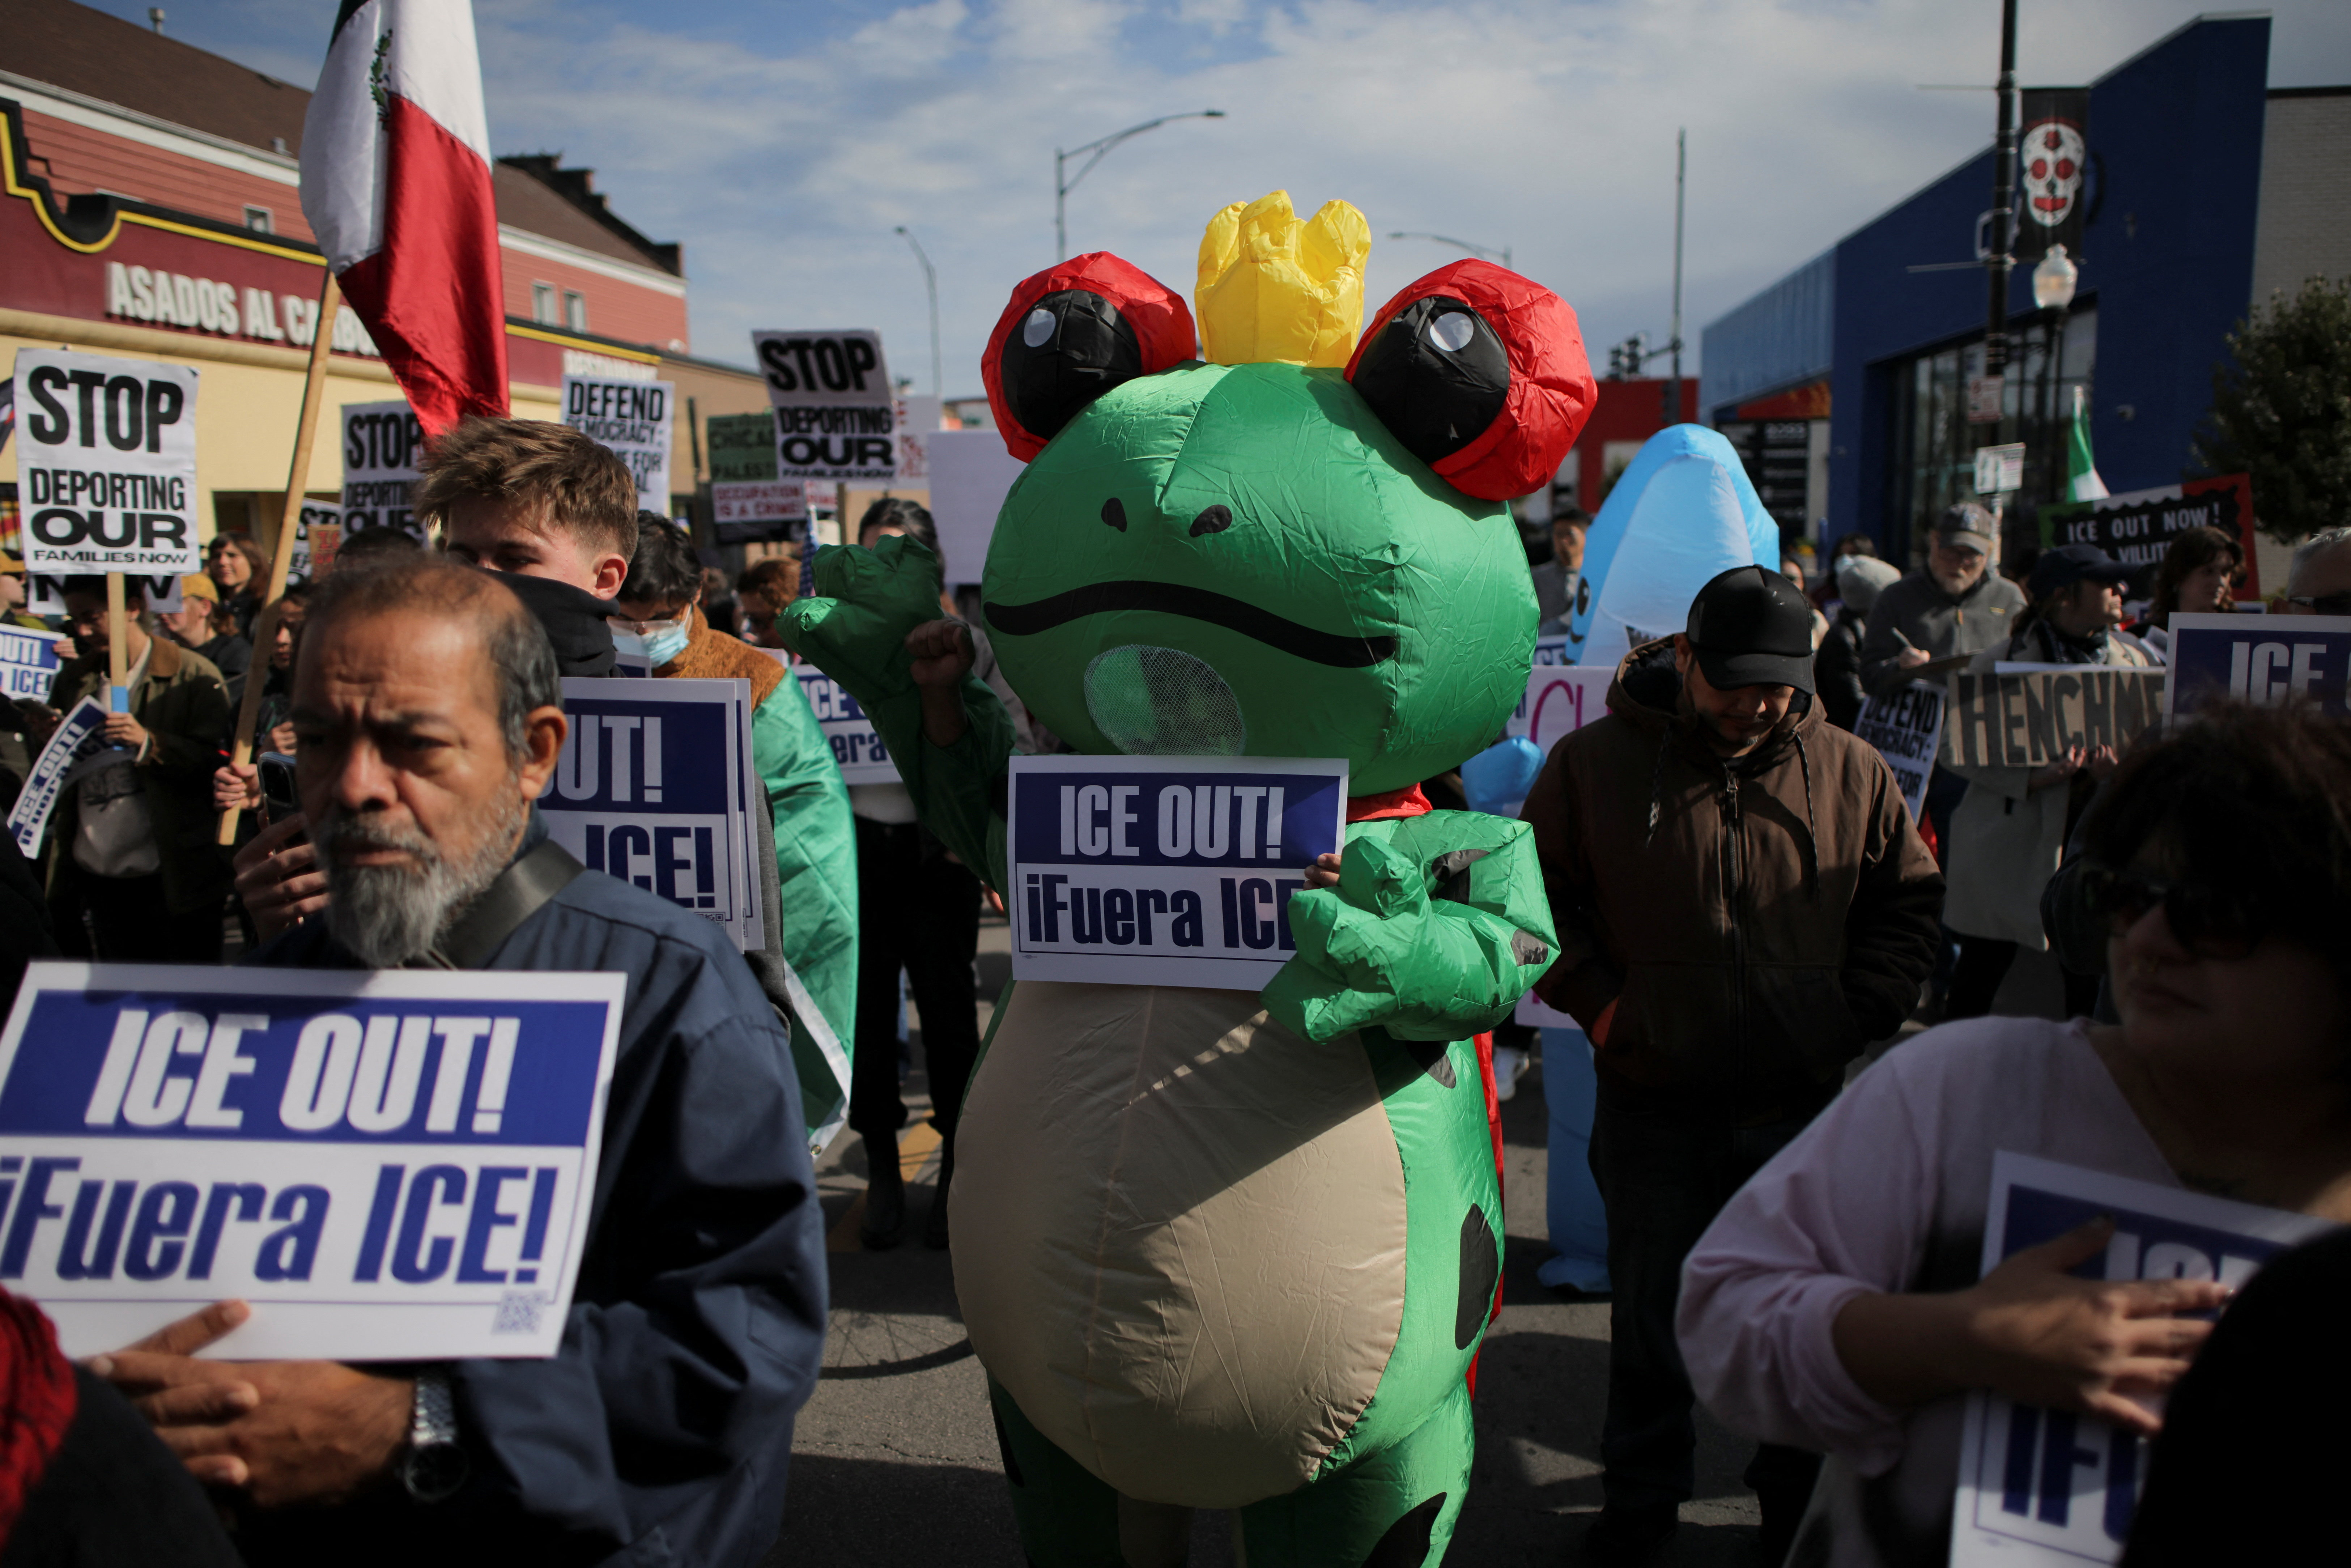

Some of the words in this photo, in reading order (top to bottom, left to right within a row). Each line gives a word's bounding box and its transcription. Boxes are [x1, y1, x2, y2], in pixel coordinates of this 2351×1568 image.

[107, 261, 240, 335] ASADOS
[243, 287, 285, 341] AL
[760, 338, 875, 392] STOP
[28, 365, 184, 453] STOP
[569, 382, 664, 421] DEFEND
[779, 407, 892, 434] DEPORTING
[346, 413, 421, 469] STOP
[782, 436, 894, 466] OUR
[29, 467, 186, 511] DEPORTING
[31, 508, 187, 549] OUR
[2067, 519, 2098, 543] ICE
[2112, 514, 2150, 540] OUT
[34, 550, 136, 563] FAMILIES
[138, 553, 188, 564] NOW
[2229, 641, 2327, 711] ICE
[1060, 785, 1139, 857] ICE
[1157, 785, 1285, 859] OUT!
[586, 824, 716, 908] ICE!
[84, 1008, 270, 1130] ICE
[279, 1013, 520, 1134] OUT!
[353, 1163, 559, 1284] ICE!
